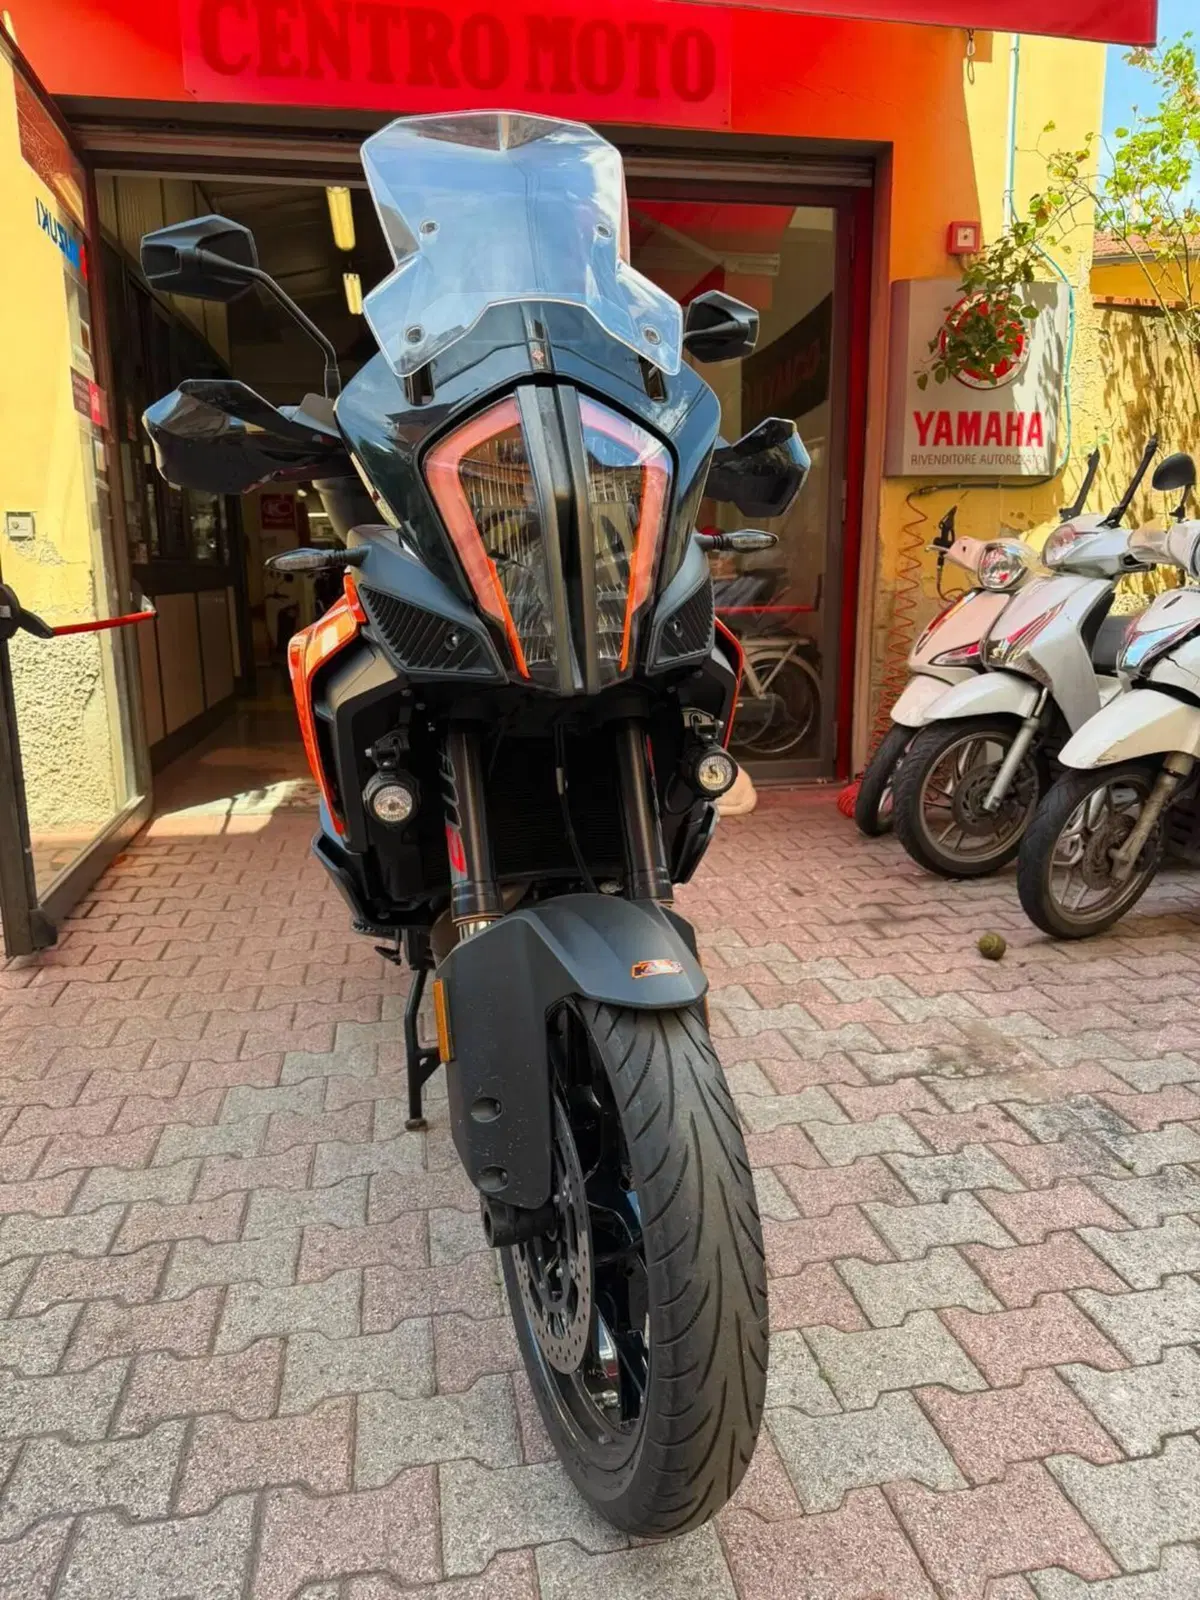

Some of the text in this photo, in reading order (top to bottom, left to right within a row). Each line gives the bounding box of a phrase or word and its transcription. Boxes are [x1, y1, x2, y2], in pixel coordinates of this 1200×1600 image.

[198, 0, 717, 103] CENTRO MOTO
[913, 411, 1044, 447] YAMAHA
[910, 453, 977, 465] RIVENDITORE
